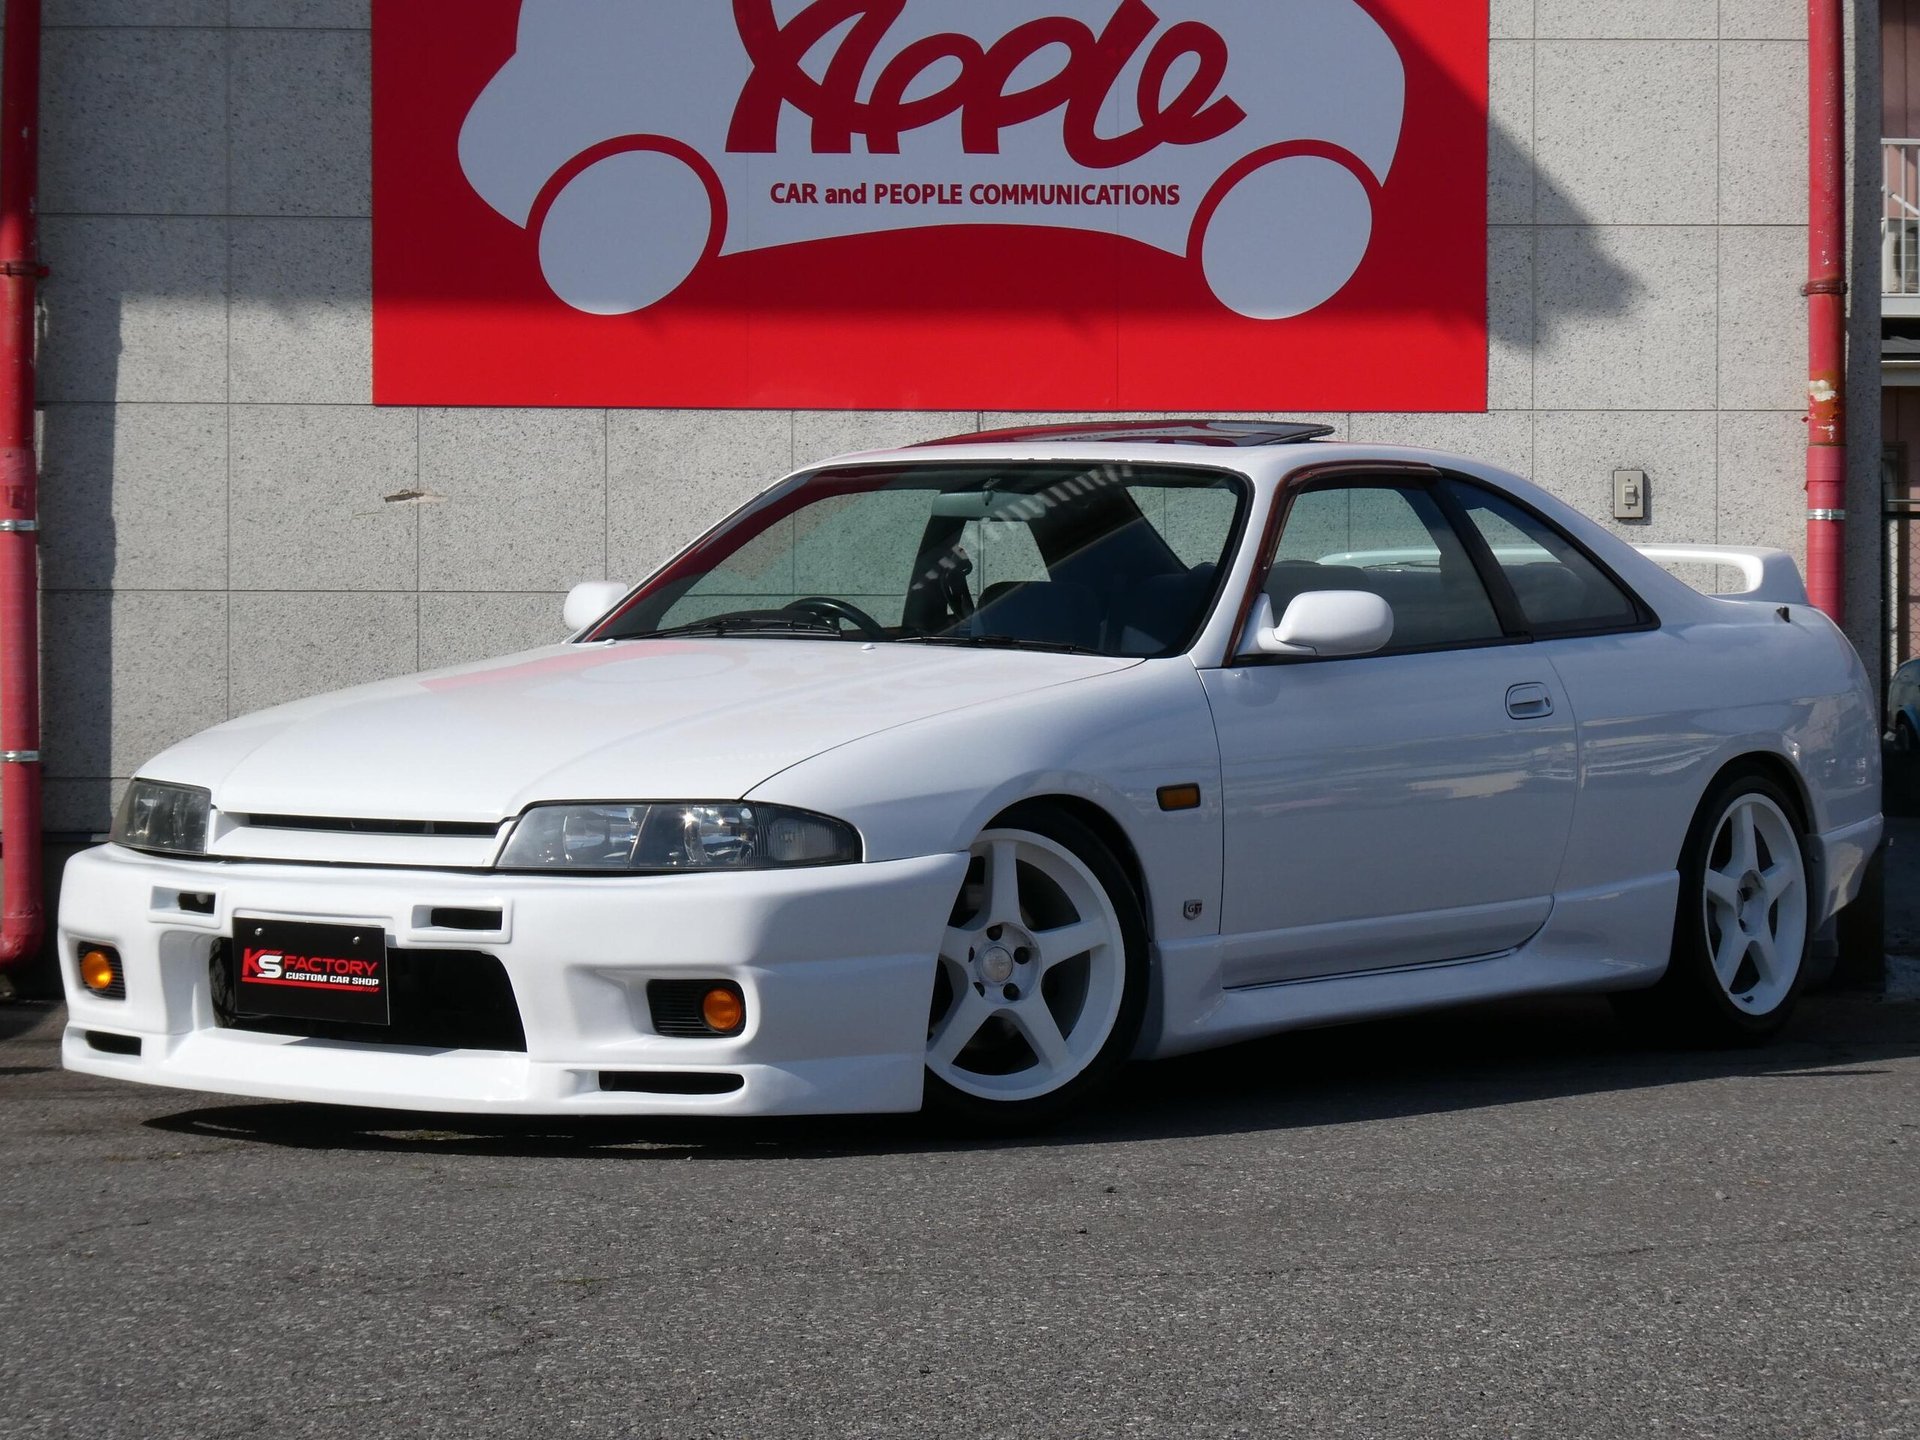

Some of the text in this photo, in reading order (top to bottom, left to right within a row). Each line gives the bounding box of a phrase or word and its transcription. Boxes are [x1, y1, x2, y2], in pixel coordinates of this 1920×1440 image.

[725, 0, 1247, 169] Apple
[770, 181, 1181, 206] CAR and PEOPLE COMMUNICATIONS
[284, 955, 378, 977] FACTORY
[285, 971, 380, 987] CUSTOM CAR SHOP
